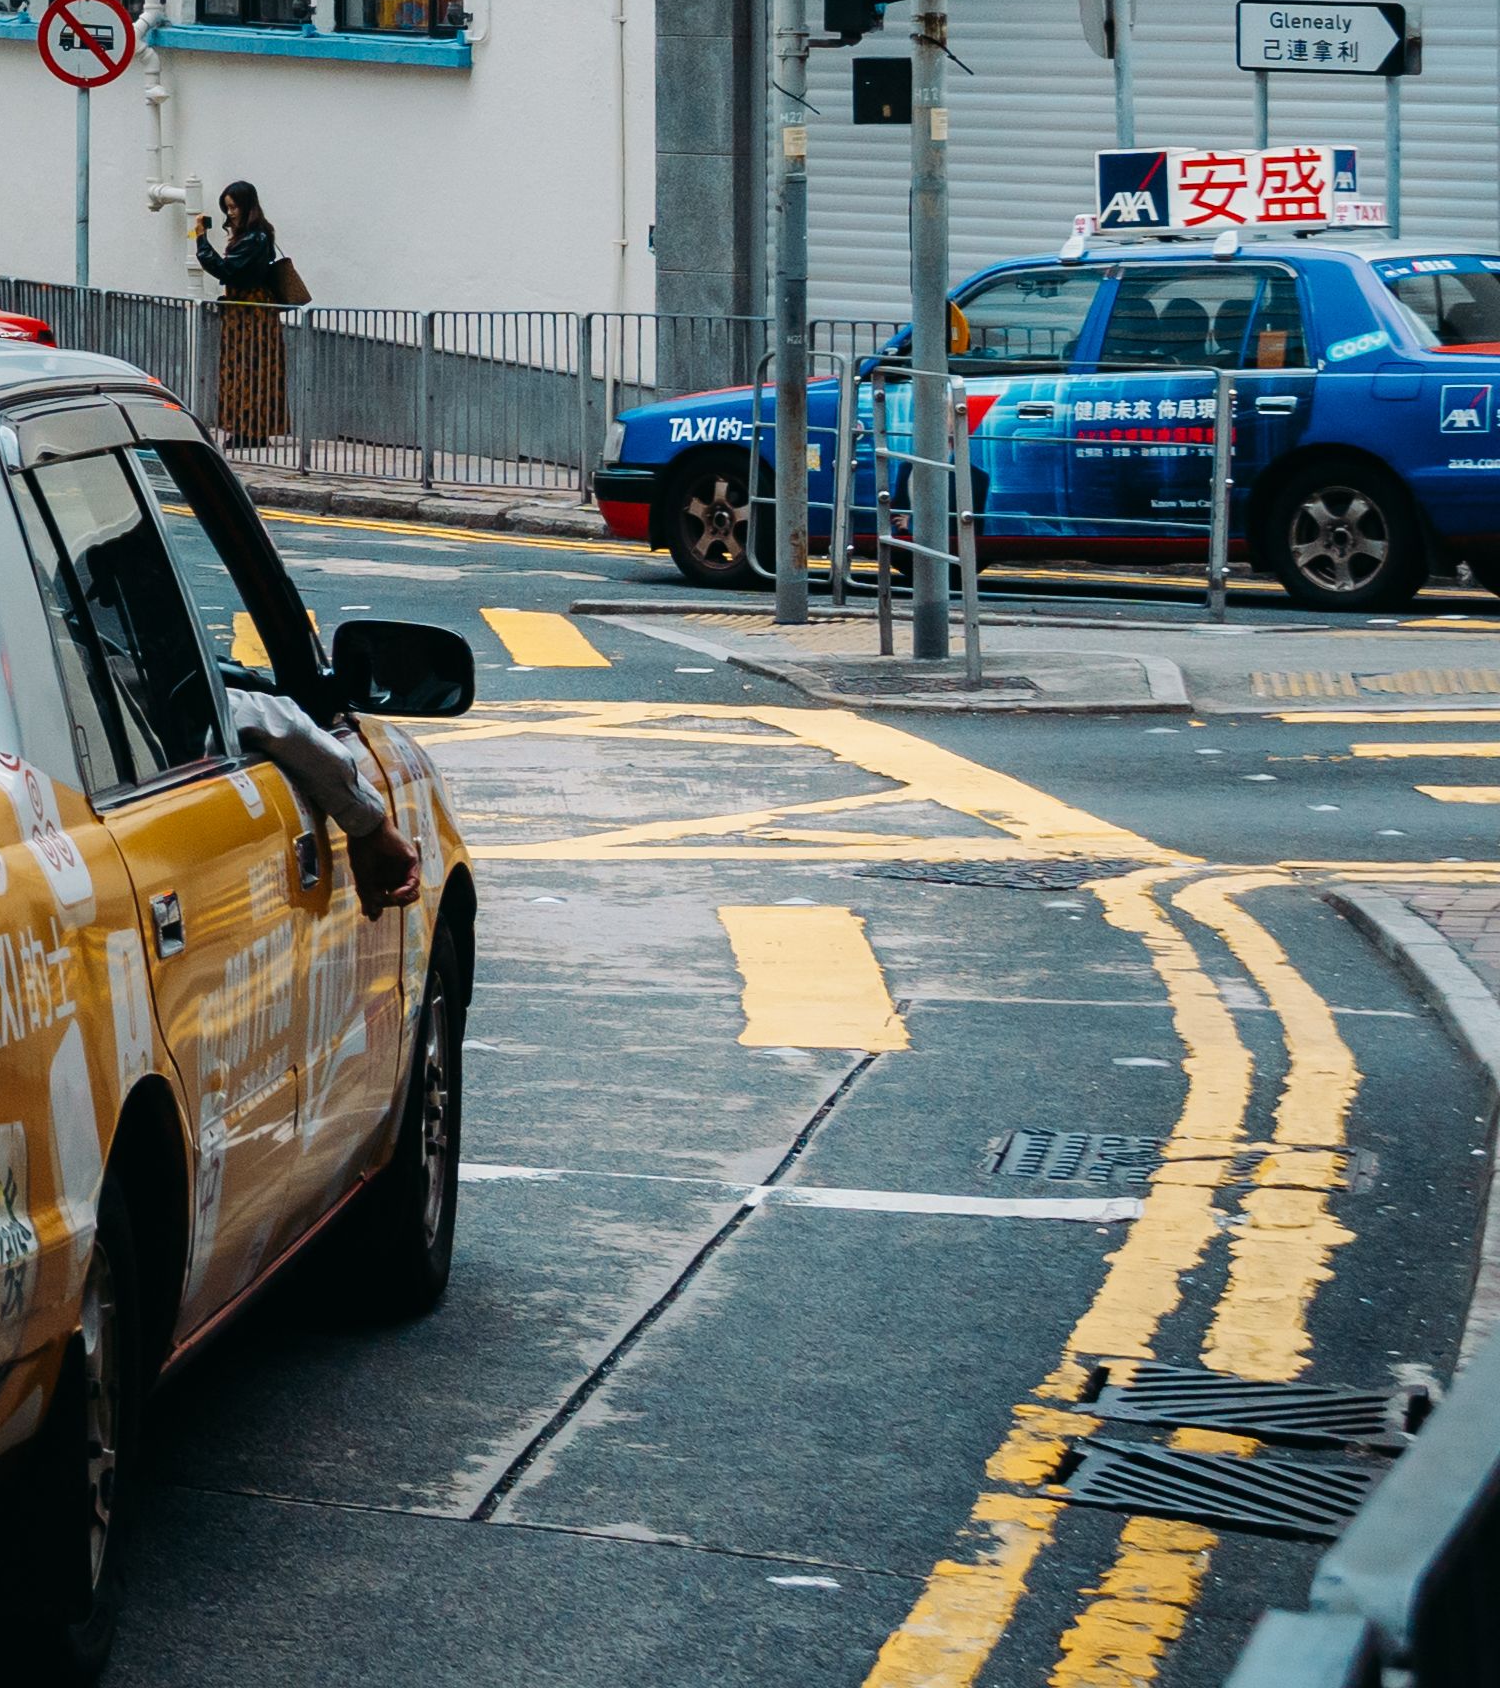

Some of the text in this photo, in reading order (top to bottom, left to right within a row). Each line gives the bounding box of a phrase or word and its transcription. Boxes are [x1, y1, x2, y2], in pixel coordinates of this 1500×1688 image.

[1270, 11, 1352, 33] Glenealy
[1264, 39, 1359, 63] 己連拿利
[1178, 148, 1327, 227] 安盛
[1100, 191, 1159, 223] AXA
[1074, 399, 1151, 421] 健康未來
[1442, 409, 1481, 428] AXA
[669, 417, 717, 442] TAXI
